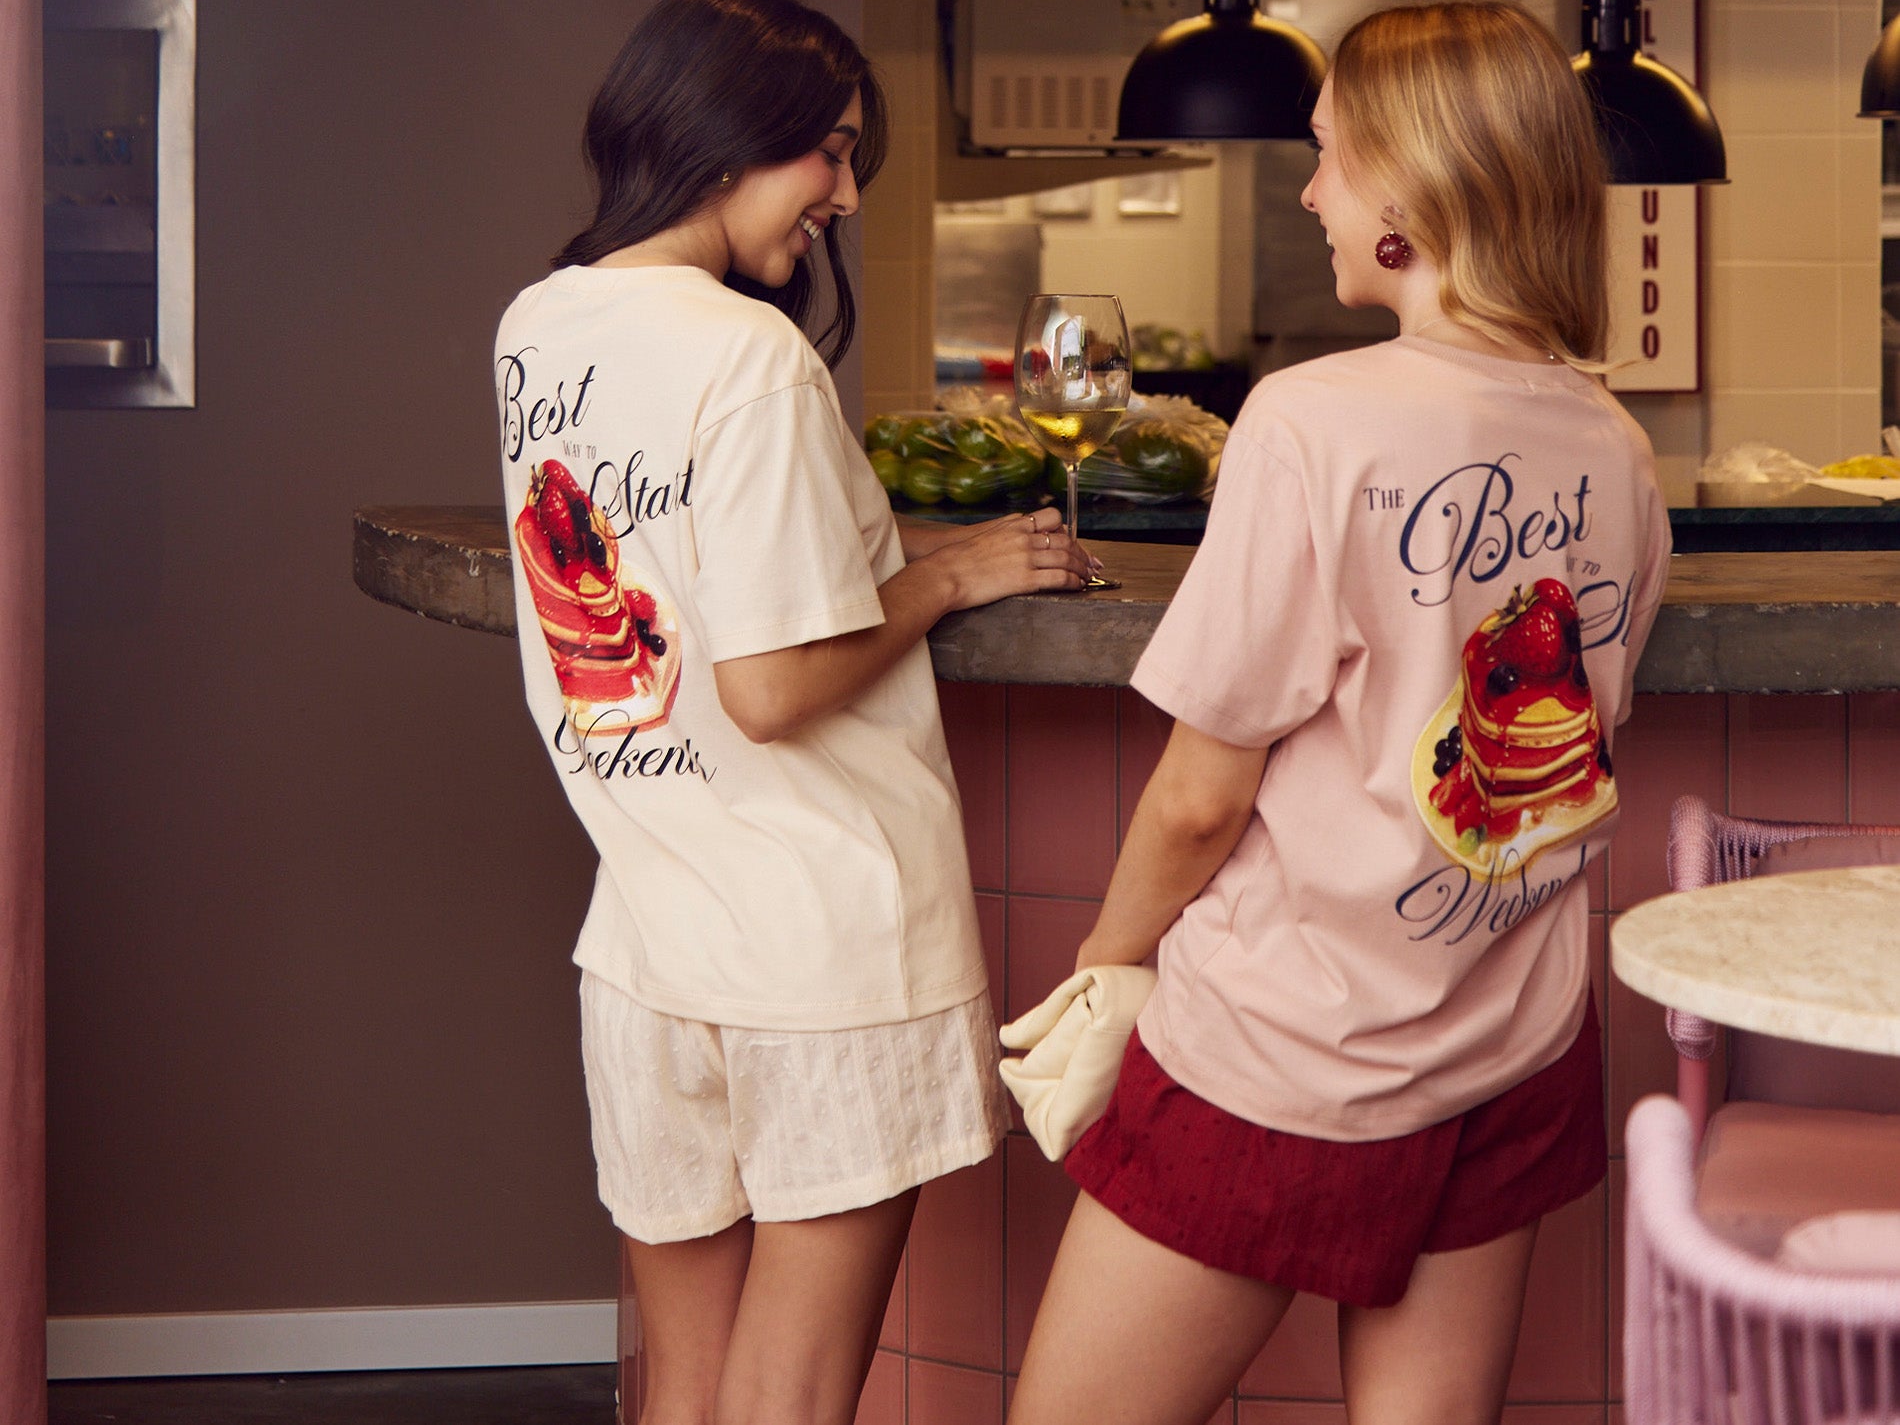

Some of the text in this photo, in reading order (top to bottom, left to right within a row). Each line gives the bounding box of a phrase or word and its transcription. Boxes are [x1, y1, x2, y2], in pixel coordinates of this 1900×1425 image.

[1641, 189, 1659, 360] UNDO
[496, 346, 597, 463] Best
[586, 445, 598, 460] TO
[1362, 452, 1593, 607] THE Best
